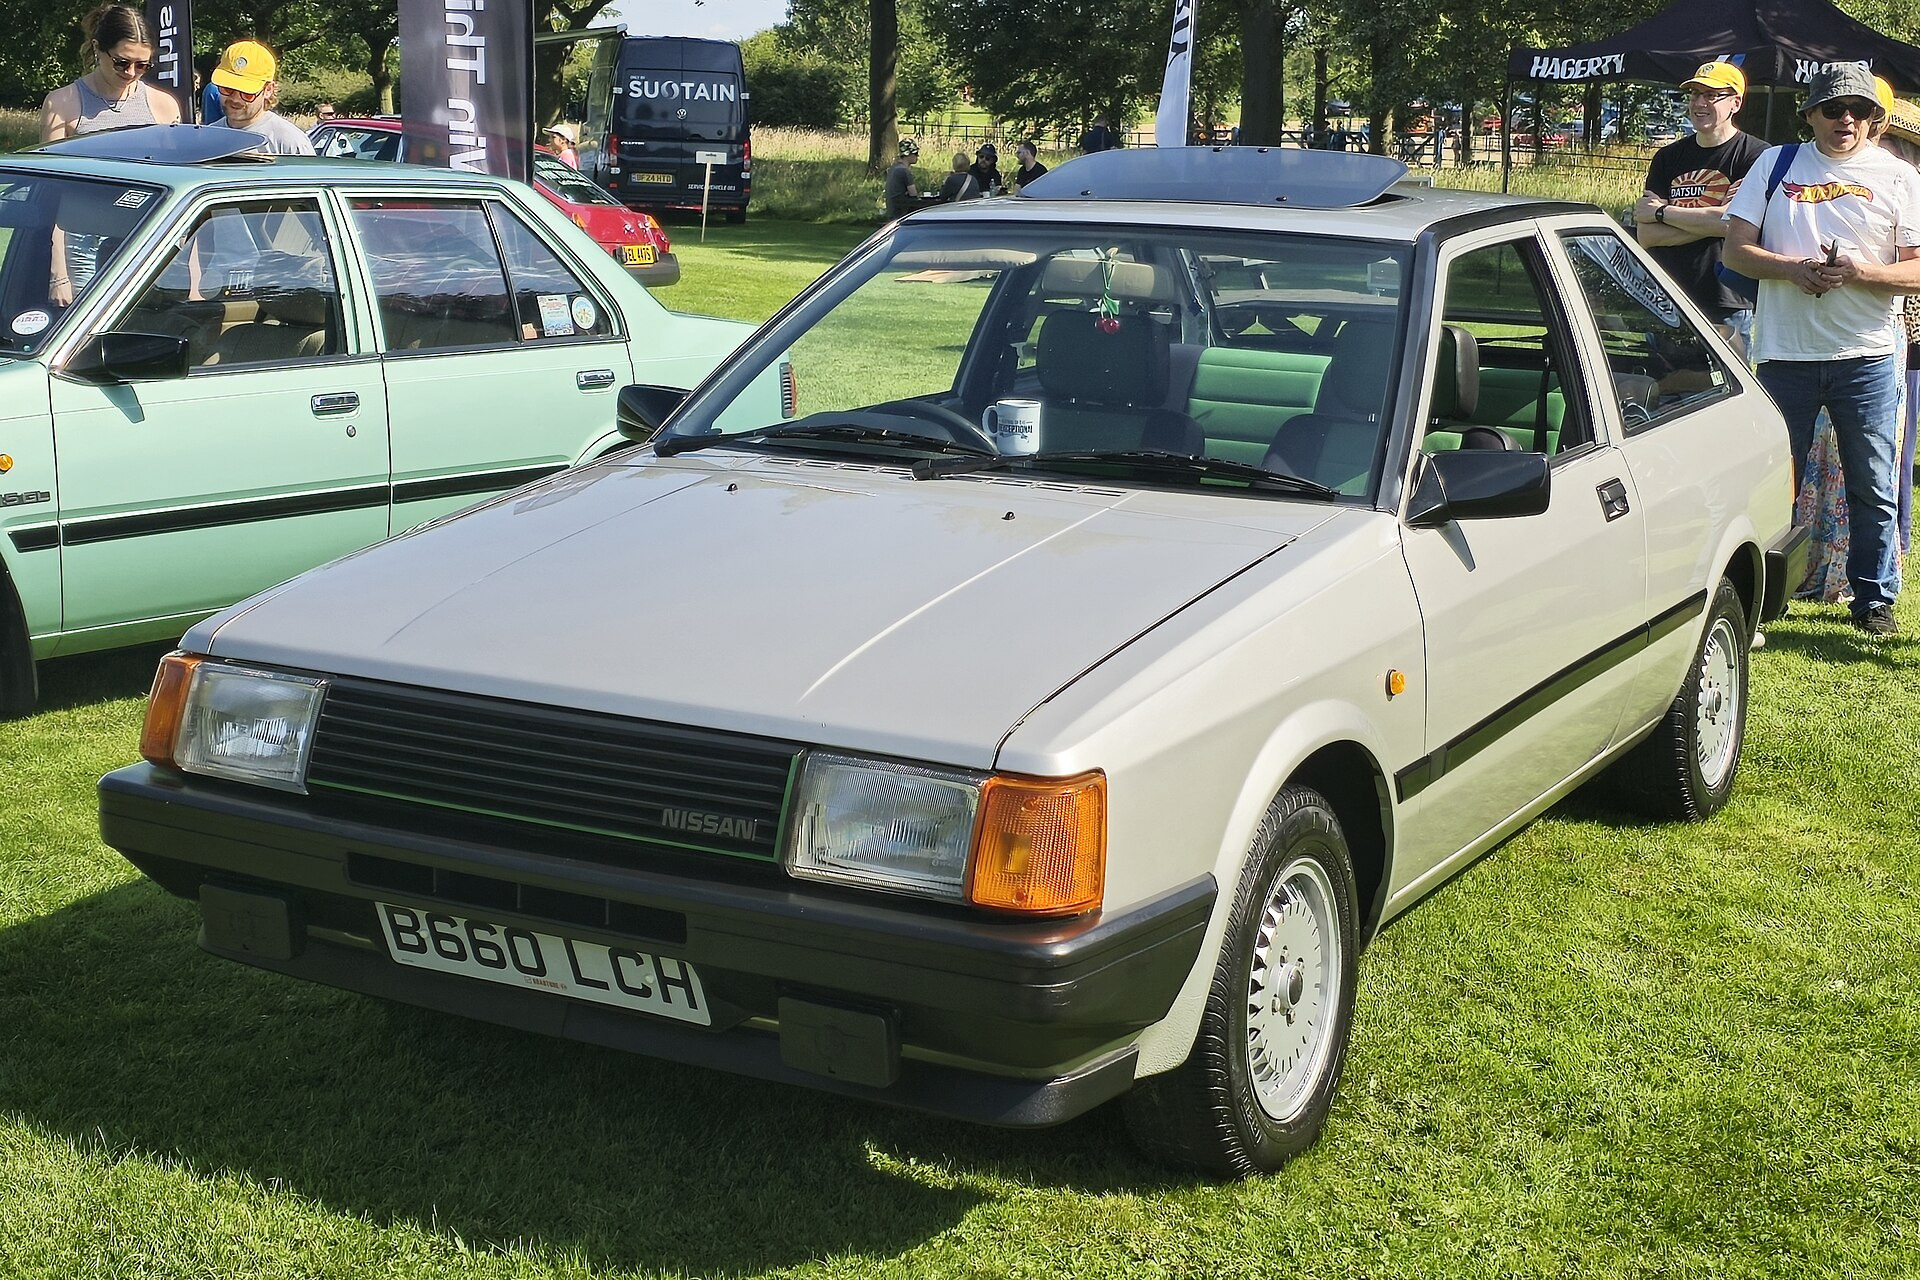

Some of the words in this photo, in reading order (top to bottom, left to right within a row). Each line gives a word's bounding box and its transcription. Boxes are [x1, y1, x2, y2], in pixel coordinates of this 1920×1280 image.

[1530, 53, 1625, 80] HAGERTY
[1670, 186, 1706, 198] DATSUN
[661, 808, 754, 840] NISSAN
[383, 904, 547, 977] B660
[562, 937, 699, 1011] LCH
